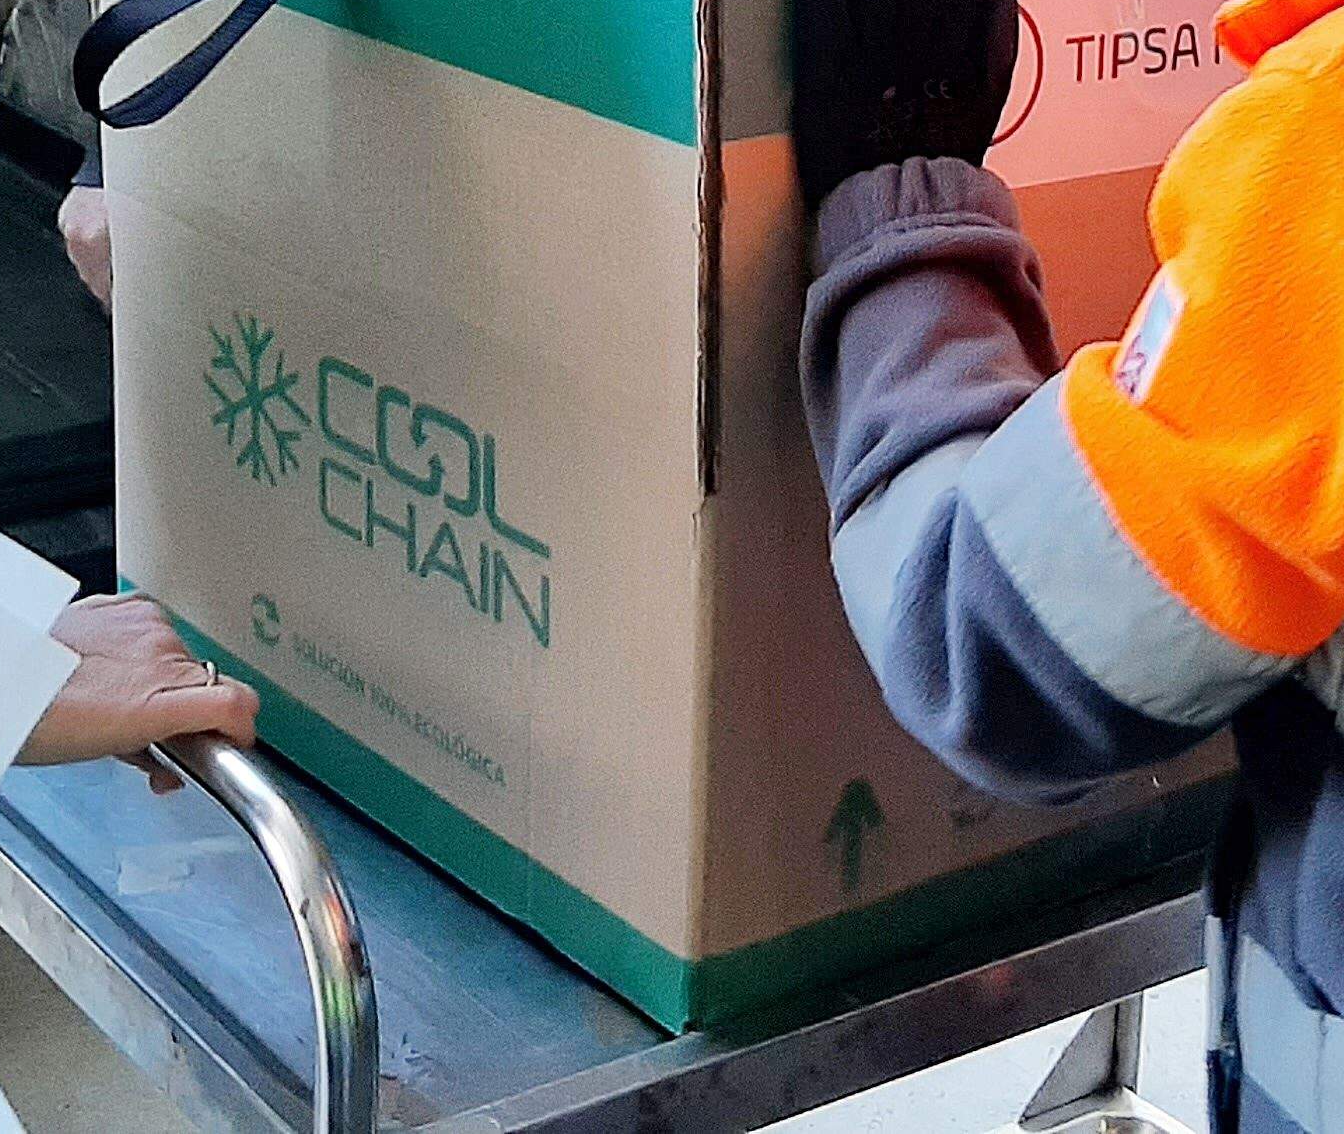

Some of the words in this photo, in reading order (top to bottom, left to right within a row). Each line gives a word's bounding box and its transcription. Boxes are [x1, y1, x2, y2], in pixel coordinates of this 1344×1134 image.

[1066, 23, 1199, 83] TIPSA
[317, 355, 550, 559] COOL
[319, 456, 550, 649] CHAIN
